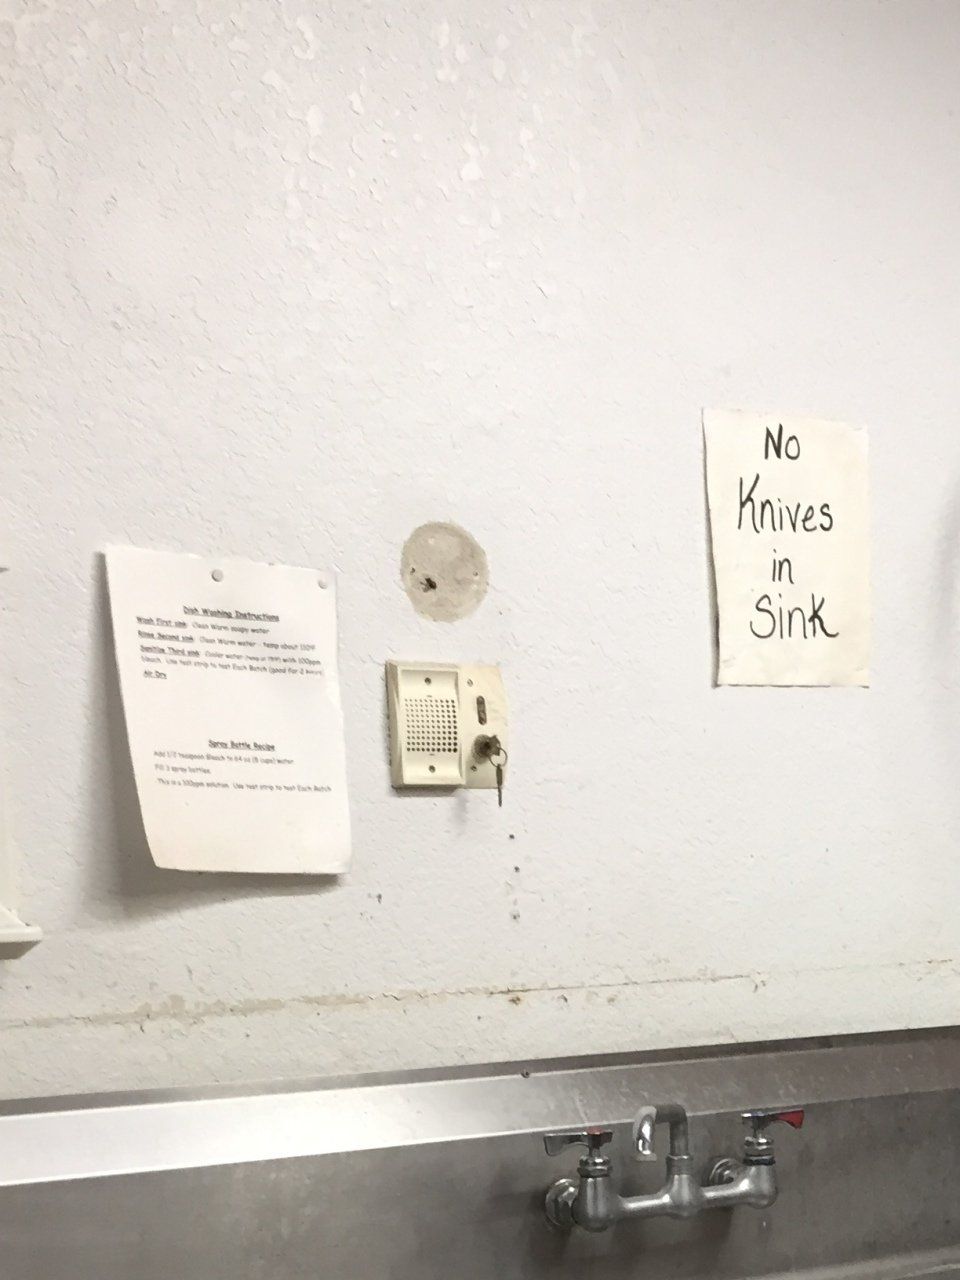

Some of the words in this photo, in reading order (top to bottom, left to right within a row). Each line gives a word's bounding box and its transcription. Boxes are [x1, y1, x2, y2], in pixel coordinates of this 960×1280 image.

[764, 423, 801, 460] No
[737, 473, 834, 533] Knives
[771, 549, 794, 584] in
[202, 608, 232, 619] Washing
[235, 610, 279, 622] Instructions
[749, 593, 839, 639] Sink
[230, 741, 251, 750] Bottle
[254, 743, 275, 751] Recipe
